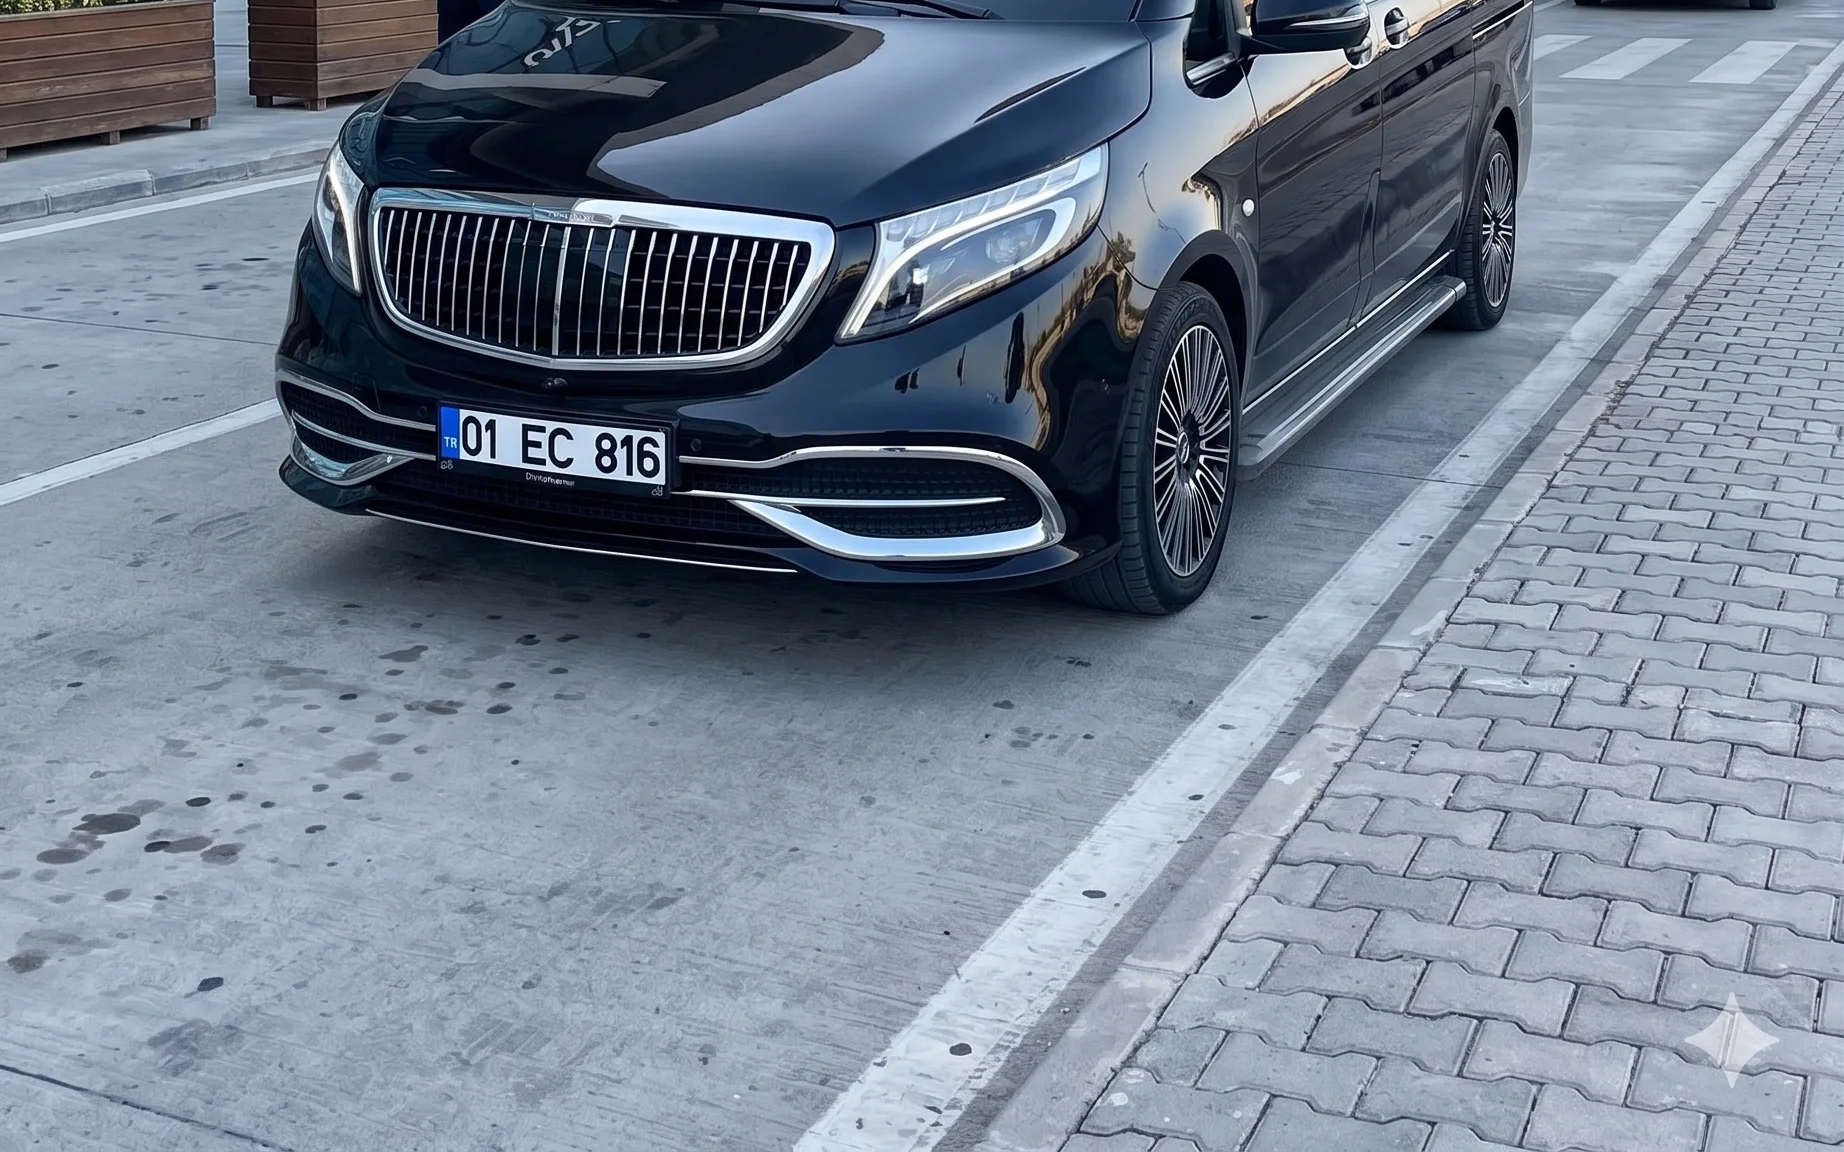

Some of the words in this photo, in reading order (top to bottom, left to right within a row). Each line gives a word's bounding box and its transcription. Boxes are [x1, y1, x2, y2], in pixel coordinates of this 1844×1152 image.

[443, 436, 458, 449] TR
[461, 415, 497, 459] 01
[521, 423, 574, 469] EC
[595, 432, 661, 478] 816
